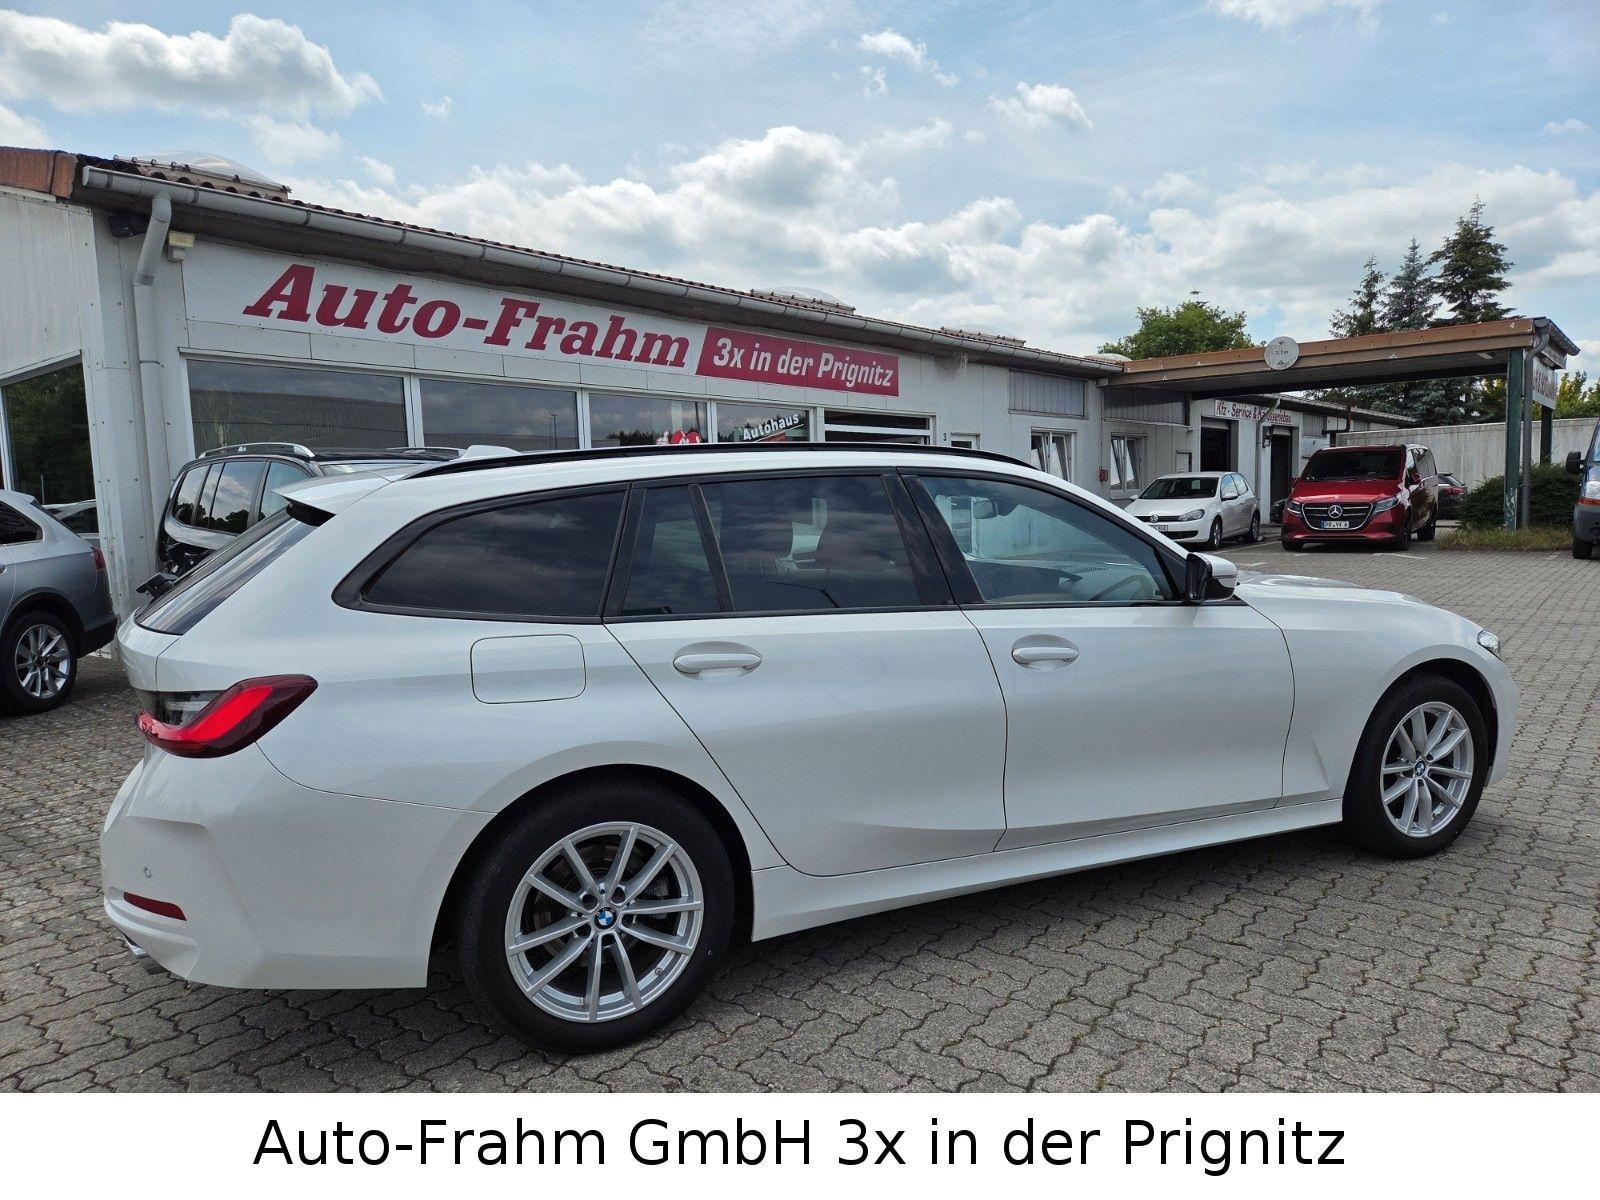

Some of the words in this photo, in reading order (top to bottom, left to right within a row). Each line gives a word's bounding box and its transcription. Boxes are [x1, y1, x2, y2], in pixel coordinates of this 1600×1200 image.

[242, 263, 689, 368] Auto-Frahm
[713, 337, 745, 369] 3x
[750, 343, 772, 371] in
[777, 348, 814, 376] der
[817, 352, 893, 388] Prignitz
[743, 412, 800, 441] Autohaus
[1216, 401, 1226, 416] Kfz
[1231, 403, 1251, 419] Service
[1252, 406, 1257, 420] &
